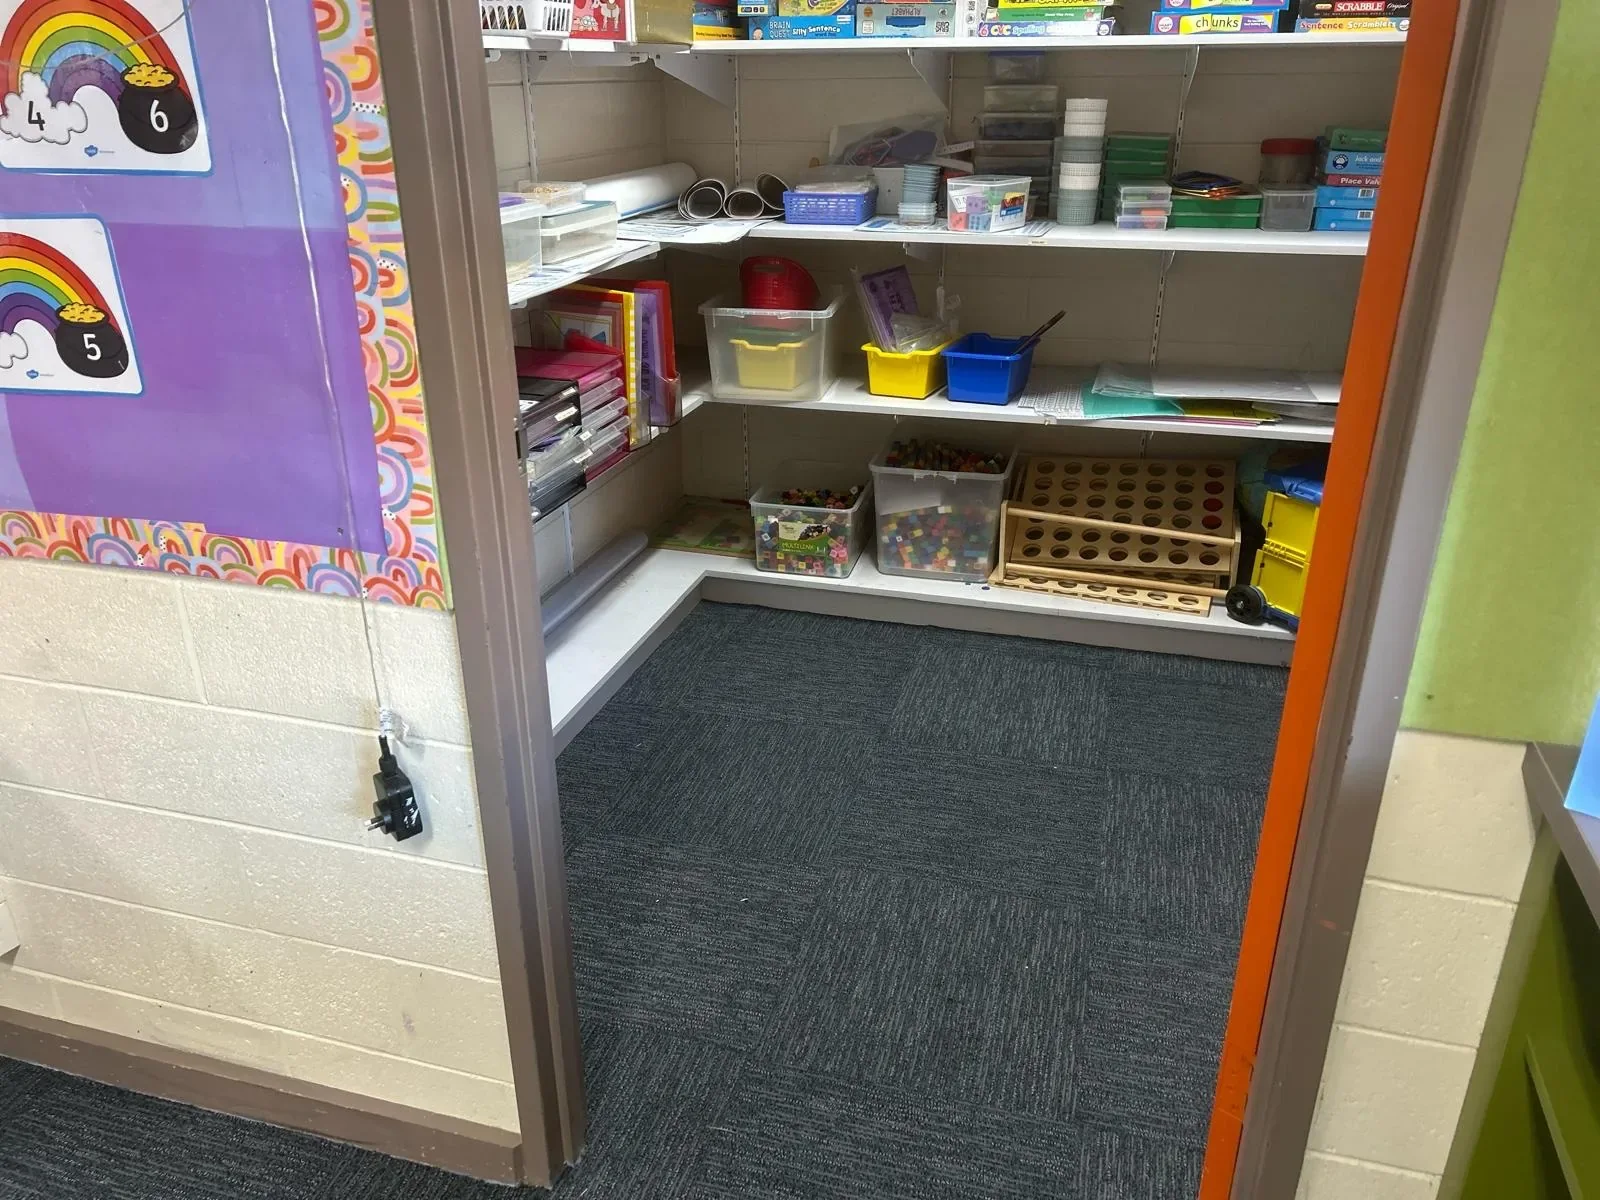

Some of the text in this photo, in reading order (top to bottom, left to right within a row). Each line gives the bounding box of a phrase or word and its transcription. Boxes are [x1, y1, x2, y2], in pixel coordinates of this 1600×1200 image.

[1337, 2, 1383, 11] SCRABBLE
[769, 21, 791, 29] BRAIN
[1196, 17, 1239, 28] chunks
[1300, 21, 1344, 30] Sentence
[27, 99, 169, 133] 4 6
[82, 333, 101, 361] 5
